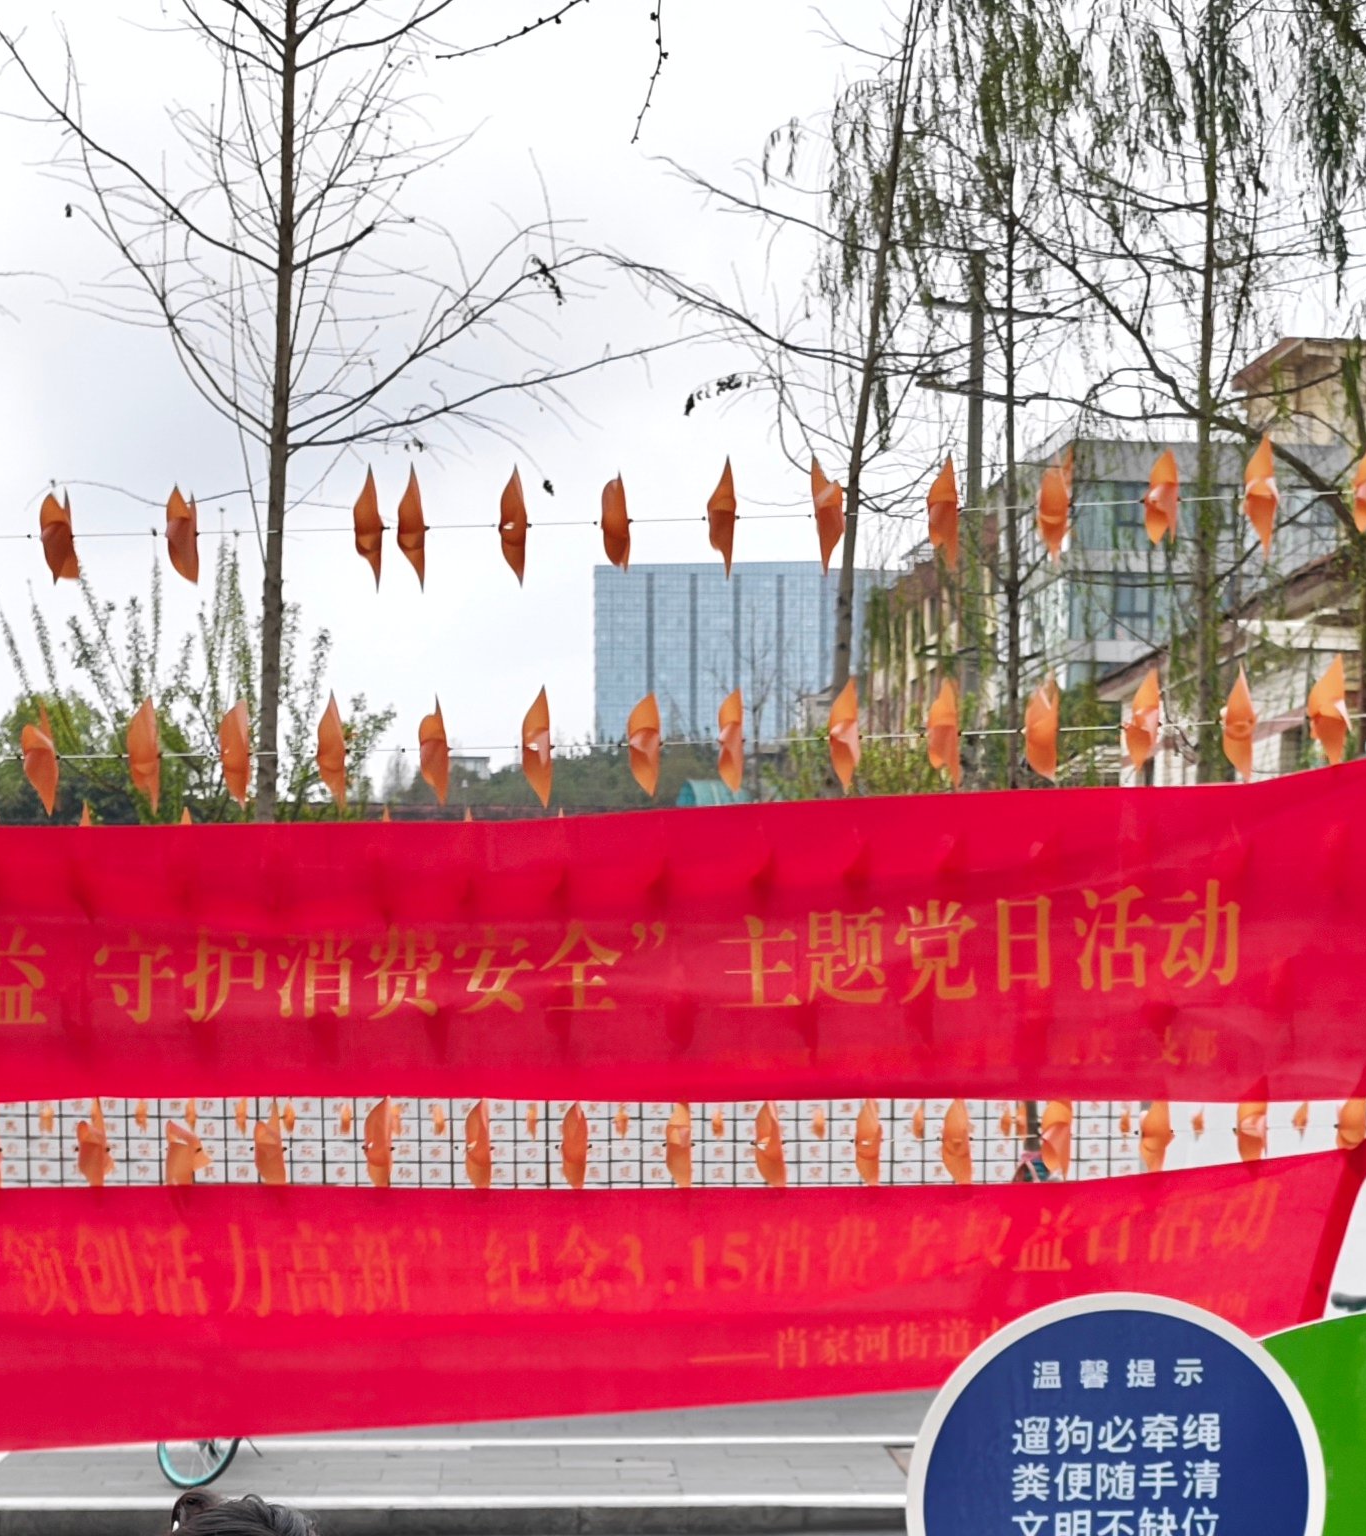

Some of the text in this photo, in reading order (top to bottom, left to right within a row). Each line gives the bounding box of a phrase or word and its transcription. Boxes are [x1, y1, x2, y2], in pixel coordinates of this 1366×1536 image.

[719, 878, 1242, 1008] 主题党日活动
[1032, 1357, 1205, 1390] 温馨提示
[1011, 1412, 1222, 1456] 遛狗必牵绳
[1011, 1460, 1222, 1502] 粪便随手清
